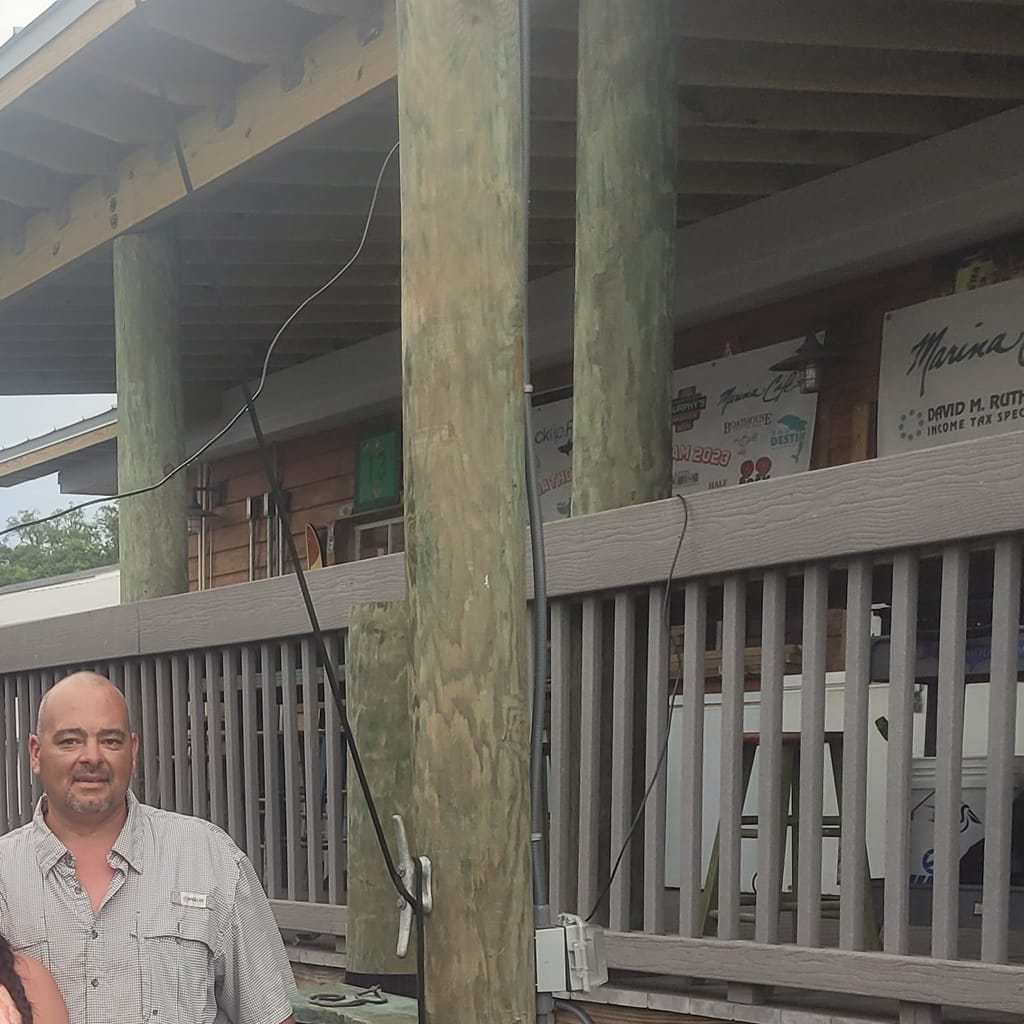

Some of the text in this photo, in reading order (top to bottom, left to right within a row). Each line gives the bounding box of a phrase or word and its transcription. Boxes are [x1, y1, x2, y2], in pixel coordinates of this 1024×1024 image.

[906, 322, 1022, 398] Marina
[927, 402, 966, 422] DAVID
[970, 398, 985, 413] M.
[927, 419, 965, 436] INCOME
[971, 413, 992, 427] TAX
[693, 446, 731, 468] 2023
